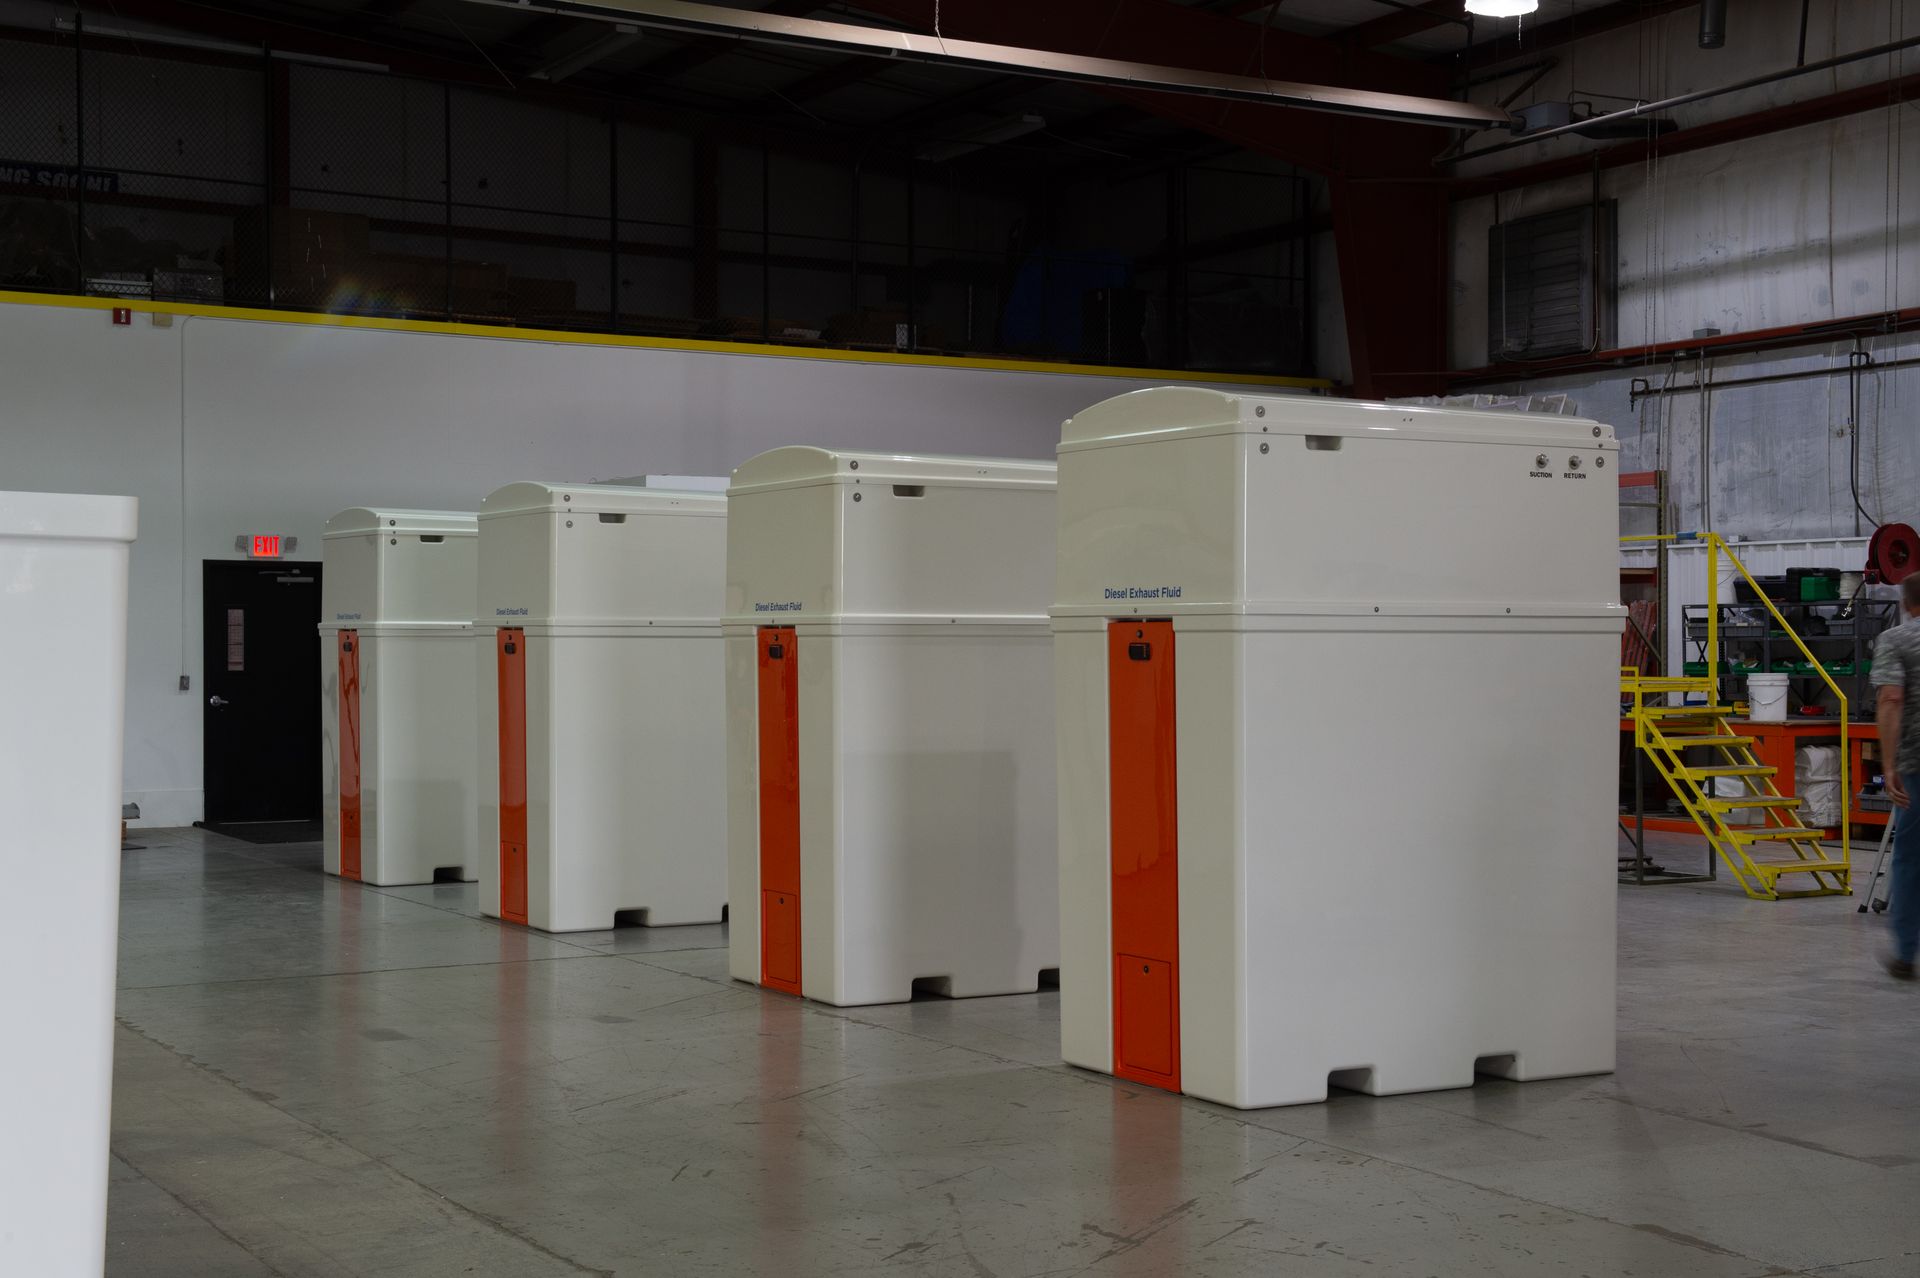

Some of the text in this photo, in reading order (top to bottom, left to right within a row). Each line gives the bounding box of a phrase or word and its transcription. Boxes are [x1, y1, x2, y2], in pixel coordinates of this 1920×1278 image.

[1529, 471, 1553, 479] SUCTION
[1563, 472, 1587, 480] RETURN
[253, 535, 280, 557] EXIT
[1104, 586, 1182, 599] Diesel Exhaust Fluid
